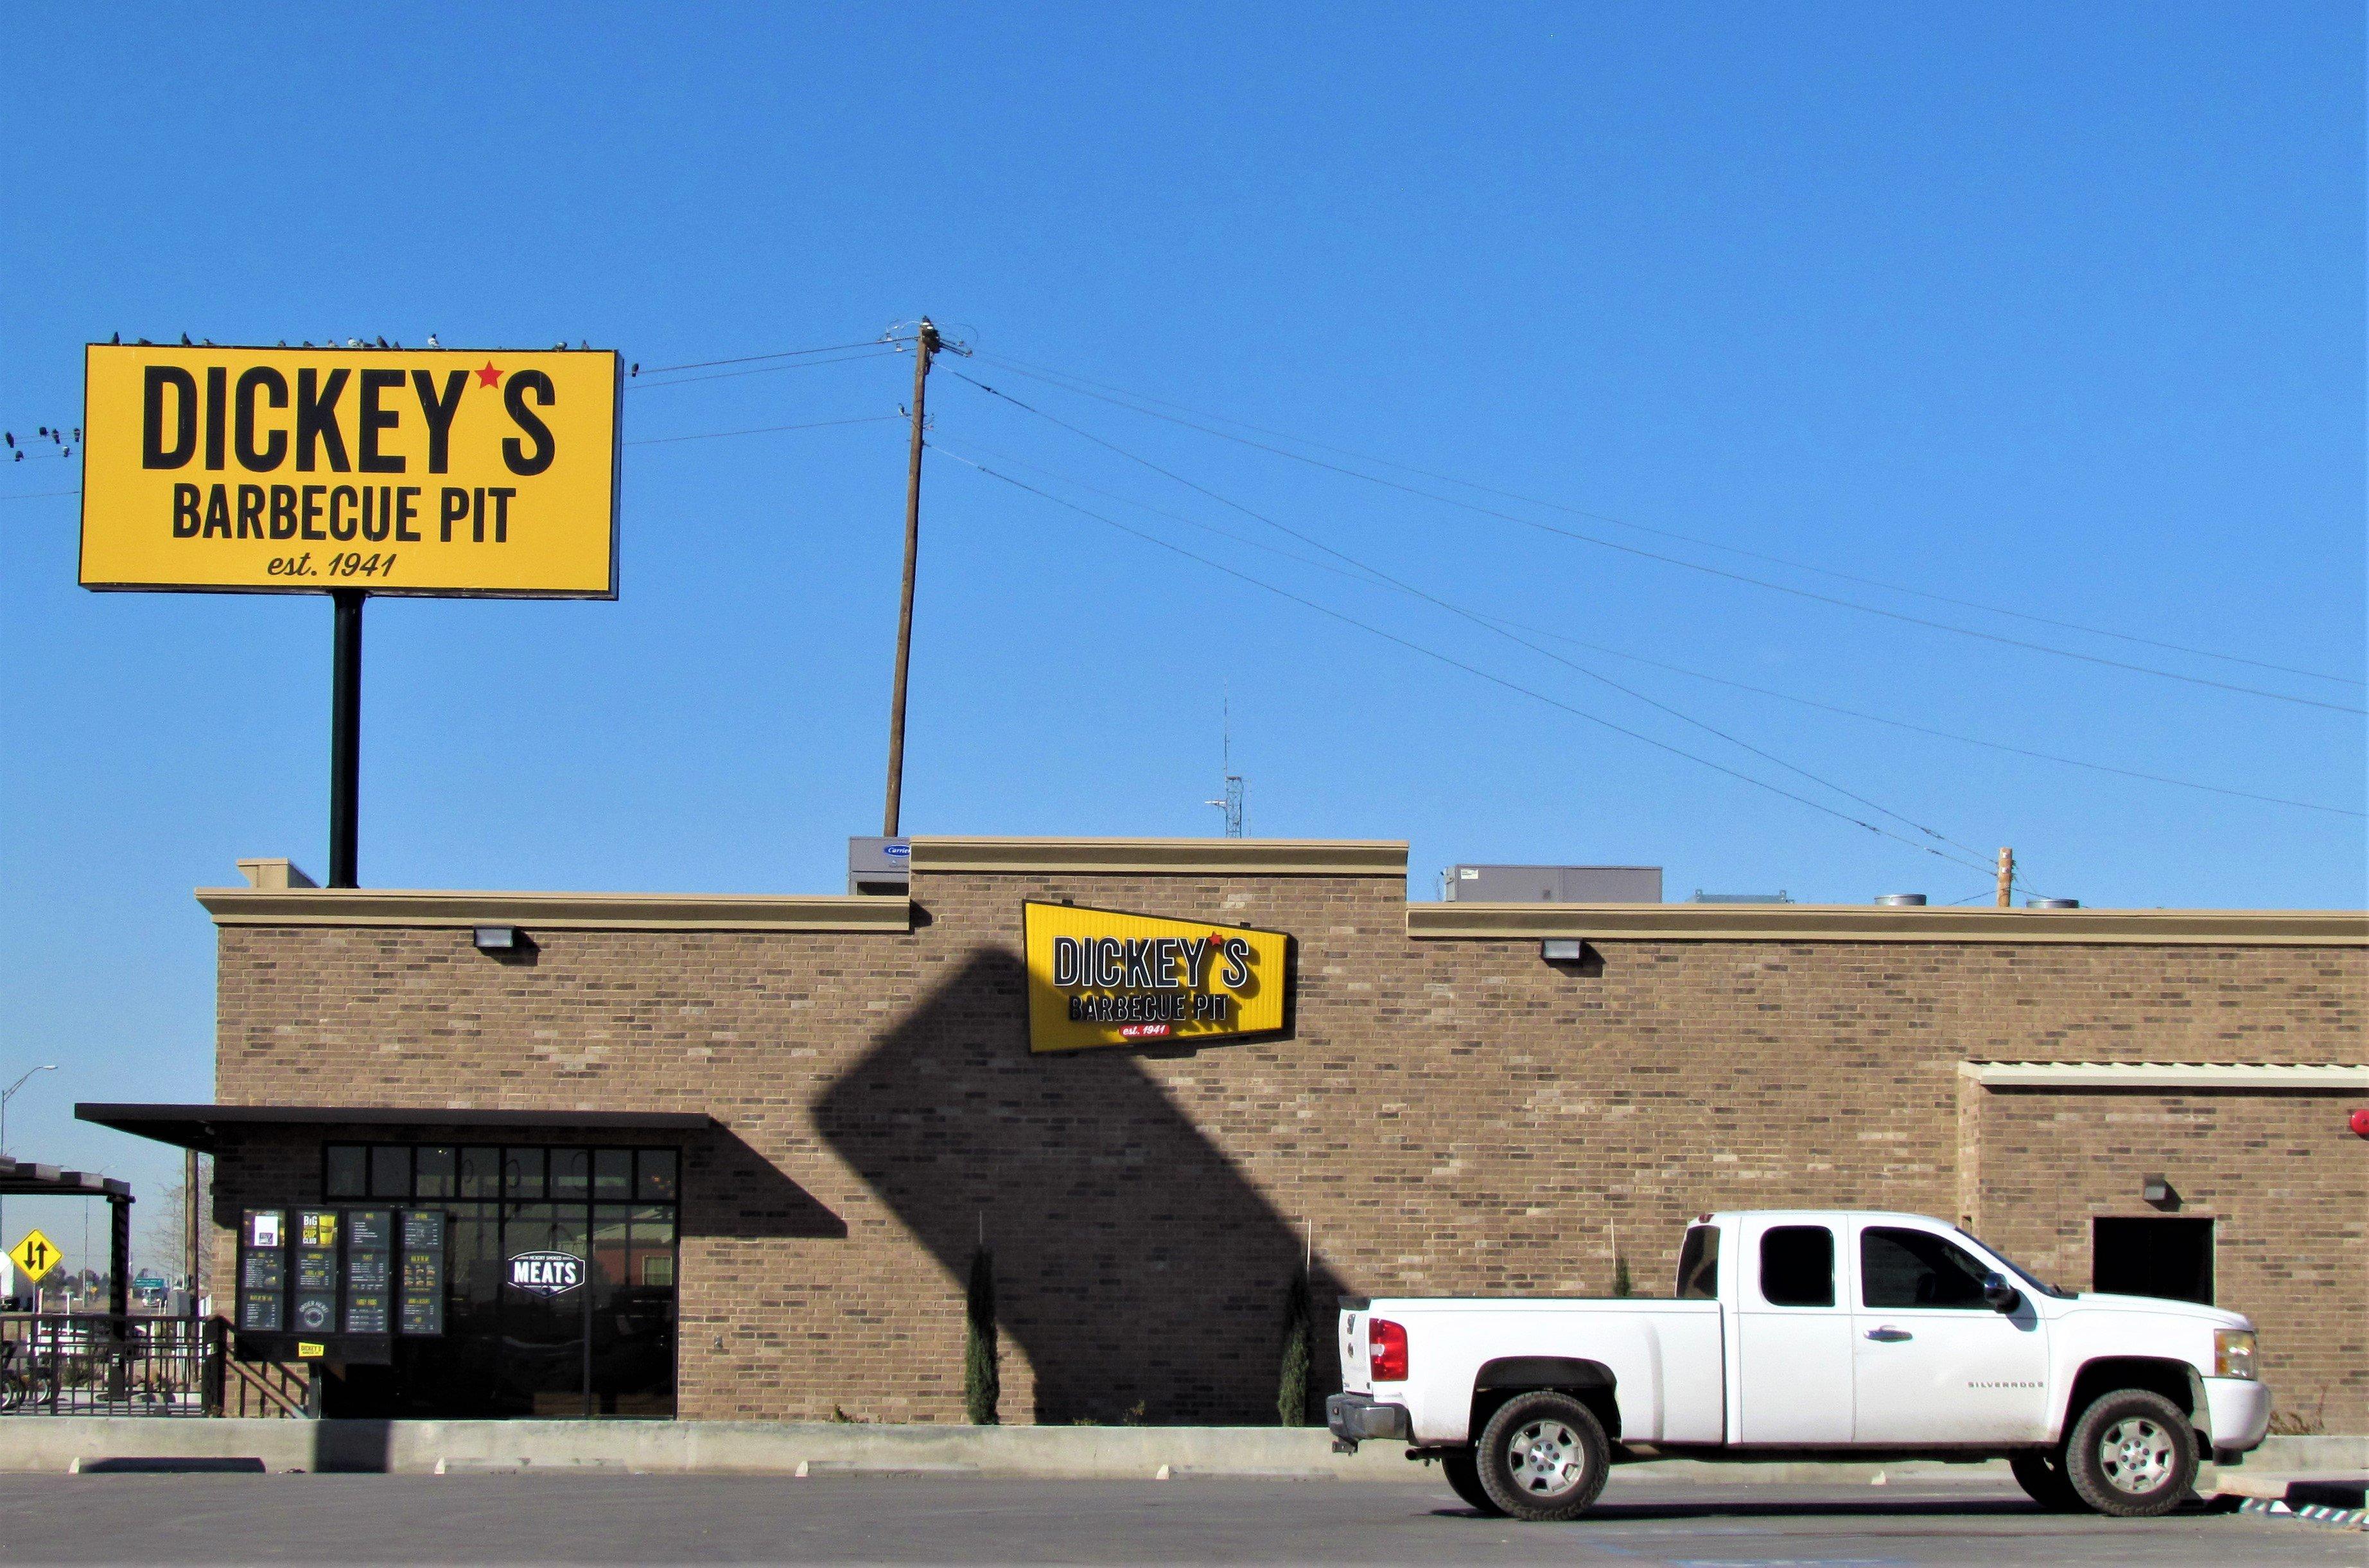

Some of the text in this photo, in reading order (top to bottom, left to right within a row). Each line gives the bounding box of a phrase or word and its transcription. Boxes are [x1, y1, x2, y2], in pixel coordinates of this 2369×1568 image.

[142, 360, 555, 476] DICKEY'S
[173, 482, 516, 543] BARBECUE PIT
[267, 553, 398, 577] est. 1941
[1053, 934, 1250, 988] DICKEY'S
[1069, 993, 1230, 1022] BARBECUE PIT
[1123, 1024, 1166, 1036] est. 1941
[514, 1261, 577, 1284] MEATS
